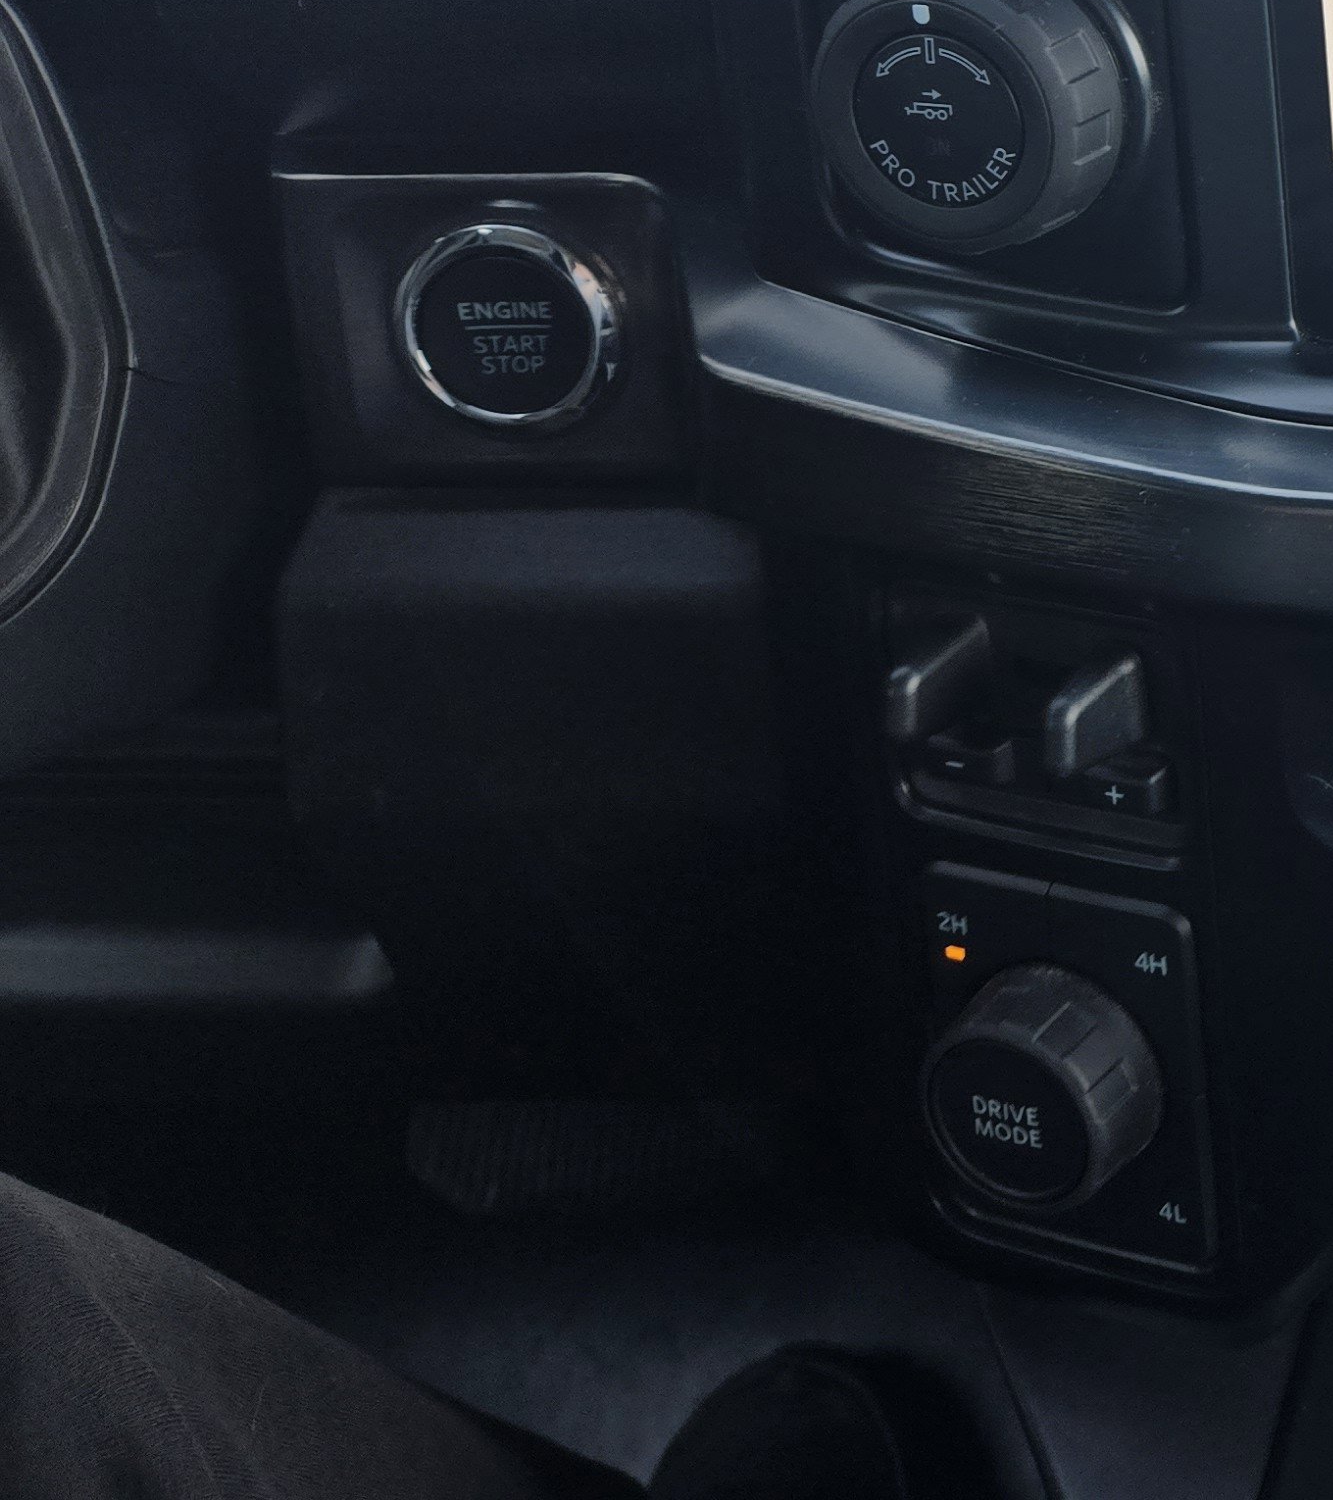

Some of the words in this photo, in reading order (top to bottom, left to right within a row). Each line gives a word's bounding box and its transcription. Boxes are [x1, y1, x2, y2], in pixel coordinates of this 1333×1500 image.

[869, 139, 916, 188] PRO
[926, 147, 1017, 202] TRAILER
[456, 301, 552, 321] ENGINE
[473, 334, 548, 354] START
[481, 354, 545, 375] STOP
[936, 911, 968, 936] 2H
[1134, 952, 1168, 976] 4H
[972, 1095, 1040, 1127] DRIVE
[975, 1117, 1043, 1149] MODE
[1158, 1202, 1187, 1224] 4L
